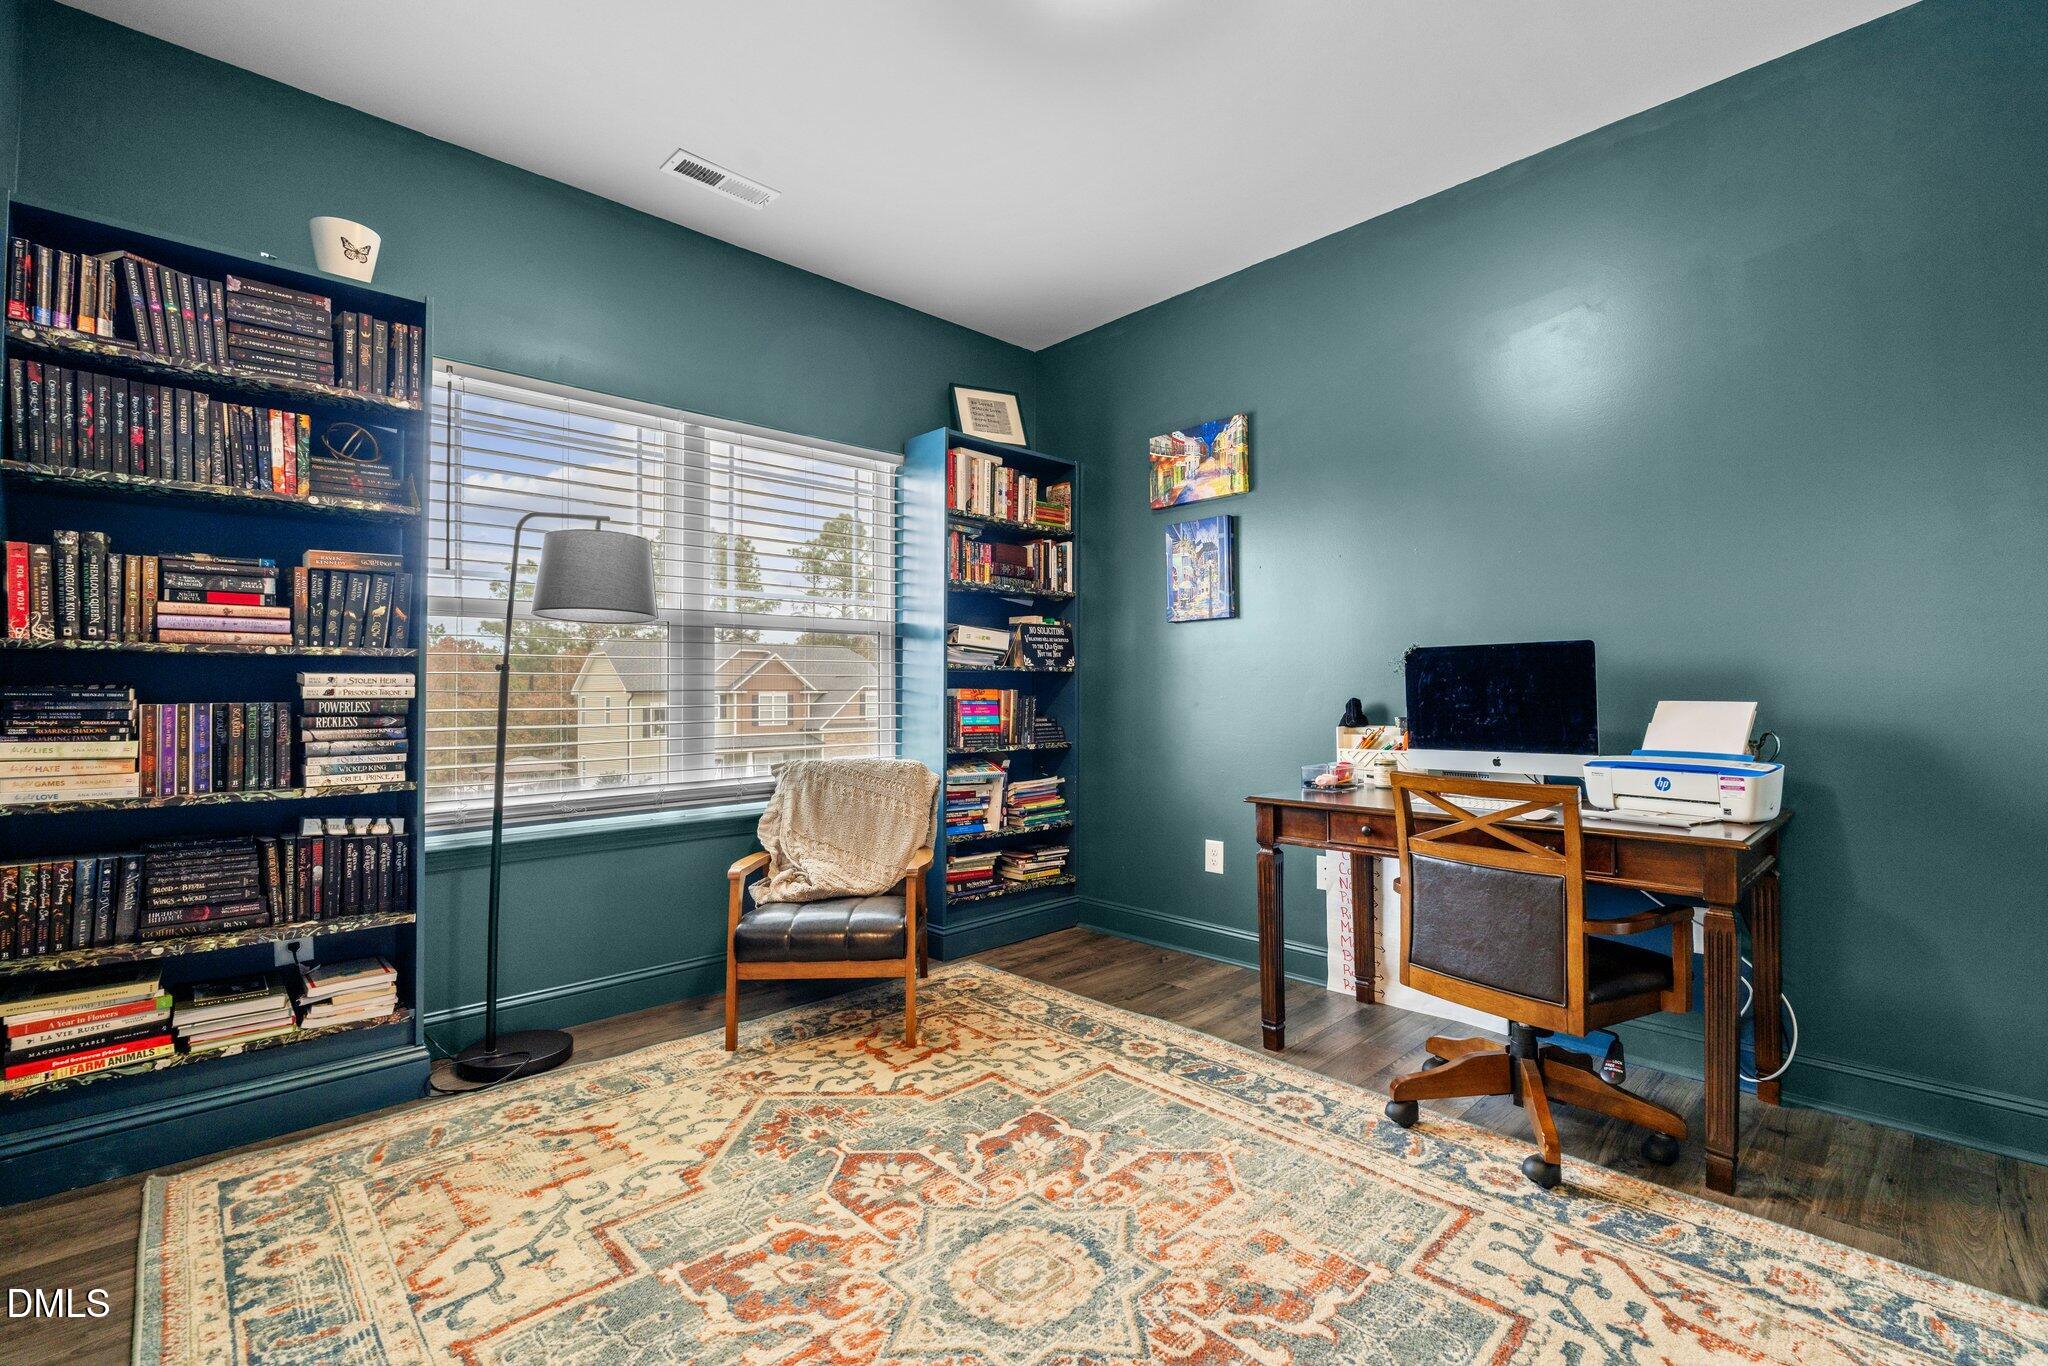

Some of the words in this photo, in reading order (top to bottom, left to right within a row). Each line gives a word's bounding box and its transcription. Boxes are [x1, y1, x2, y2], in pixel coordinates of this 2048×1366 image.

[131, 281, 139, 297] GODS
[162, 400, 171, 417] EVER
[65, 564, 77, 602] FOXGLOVE
[89, 564, 99, 598] HEMLOCK
[350, 577, 358, 602] KENNEDY
[374, 577, 383, 604] KENNEDY
[17, 590, 25, 611] WOLF
[41, 586, 49, 616] THRONE
[65, 602, 77, 622] KING
[89, 598, 101, 624] QUEEN
[1028, 626, 1037, 635] NO
[1037, 626, 1065, 636] SOLICITING
[1037, 649, 1046, 658] NOT
[1044, 642, 1053, 651] OLD
[1053, 643, 1064, 651] GODS
[349, 676, 378, 686] STOLEN
[380, 677, 398, 685] HEIR
[319, 701, 372, 713] POWERLESS
[231, 707, 241, 739] SCARRED
[247, 706, 257, 740] WRETCHED
[315, 716, 359, 728] RECKLESS
[35, 765, 61, 773] HATE
[338, 765, 368, 773] WICKED
[34, 780, 66, 788] GAMES
[340, 775, 363, 783] CRUEL
[36, 793, 59, 801] LOVE
[153, 885, 174, 894] BLOOD
[153, 898, 176, 906] WINGS
[182, 894, 208, 903] WICKED
[148, 909, 183, 918] HIGHEST
[148, 915, 184, 924] BIDDER
[142, 926, 197, 938] GOTHIKANA
[223, 920, 248, 928] RUNYX
[6, 1005, 35, 1013] ANTHONY
[101, 990, 129, 998] COOKBOOK
[56, 1018, 75, 1028] Year
[78, 1016, 86, 1024] in
[87, 1010, 120, 1022] Flowers
[41, 1034, 54, 1043] LA
[56, 1029, 75, 1038] VIE
[77, 1022, 112, 1035] RUSTIC
[28, 1045, 76, 1059] MAGNOLIA
[80, 1038, 107, 1049] TABLE
[52, 1057, 71, 1067] food
[70, 1052, 104, 1063] between
[102, 1047, 129, 1058] friends
[69, 1060, 107, 1075] FARM
[107, 1048, 157, 1067] ANIMALS
